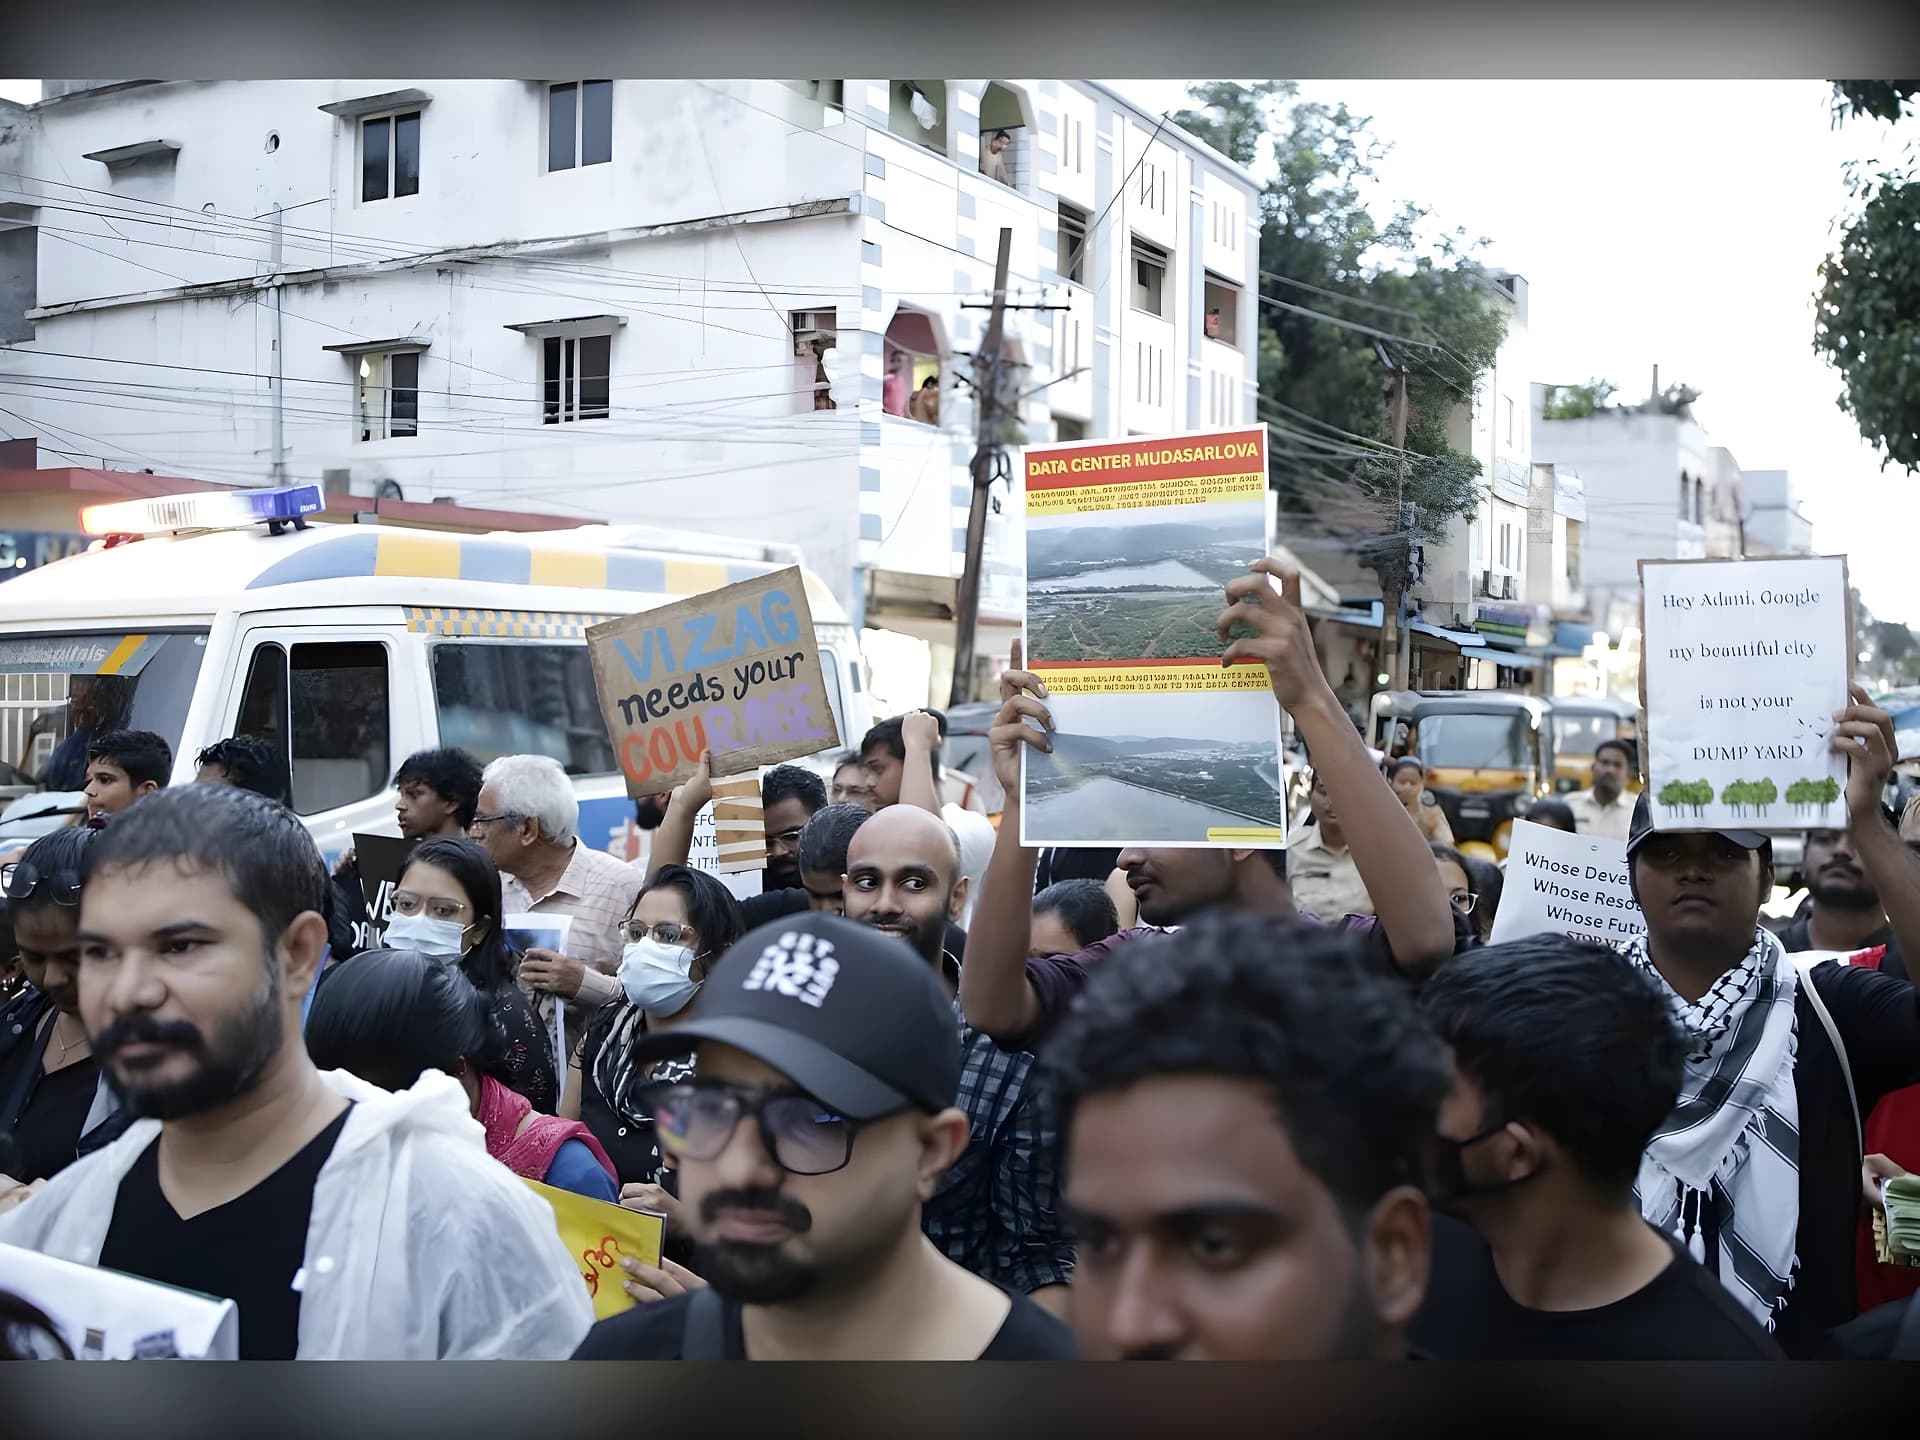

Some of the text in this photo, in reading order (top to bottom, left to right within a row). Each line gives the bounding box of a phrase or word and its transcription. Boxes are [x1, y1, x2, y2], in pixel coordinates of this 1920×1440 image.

[1028, 442, 1259, 477] DATA CENTER MUDASARLOVA
[613, 589, 799, 683] VIZAG
[1669, 646, 1695, 662] my
[617, 651, 804, 726] needs your
[1719, 695, 1746, 709] not
[1751, 695, 1794, 712] your
[619, 683, 826, 785] COURAGE
[1693, 744, 1804, 761] DUMP YARD
[1524, 850, 1631, 886] Whose Deve
[1533, 877, 1590, 903] Whose
[1546, 903, 1603, 929] Whose
